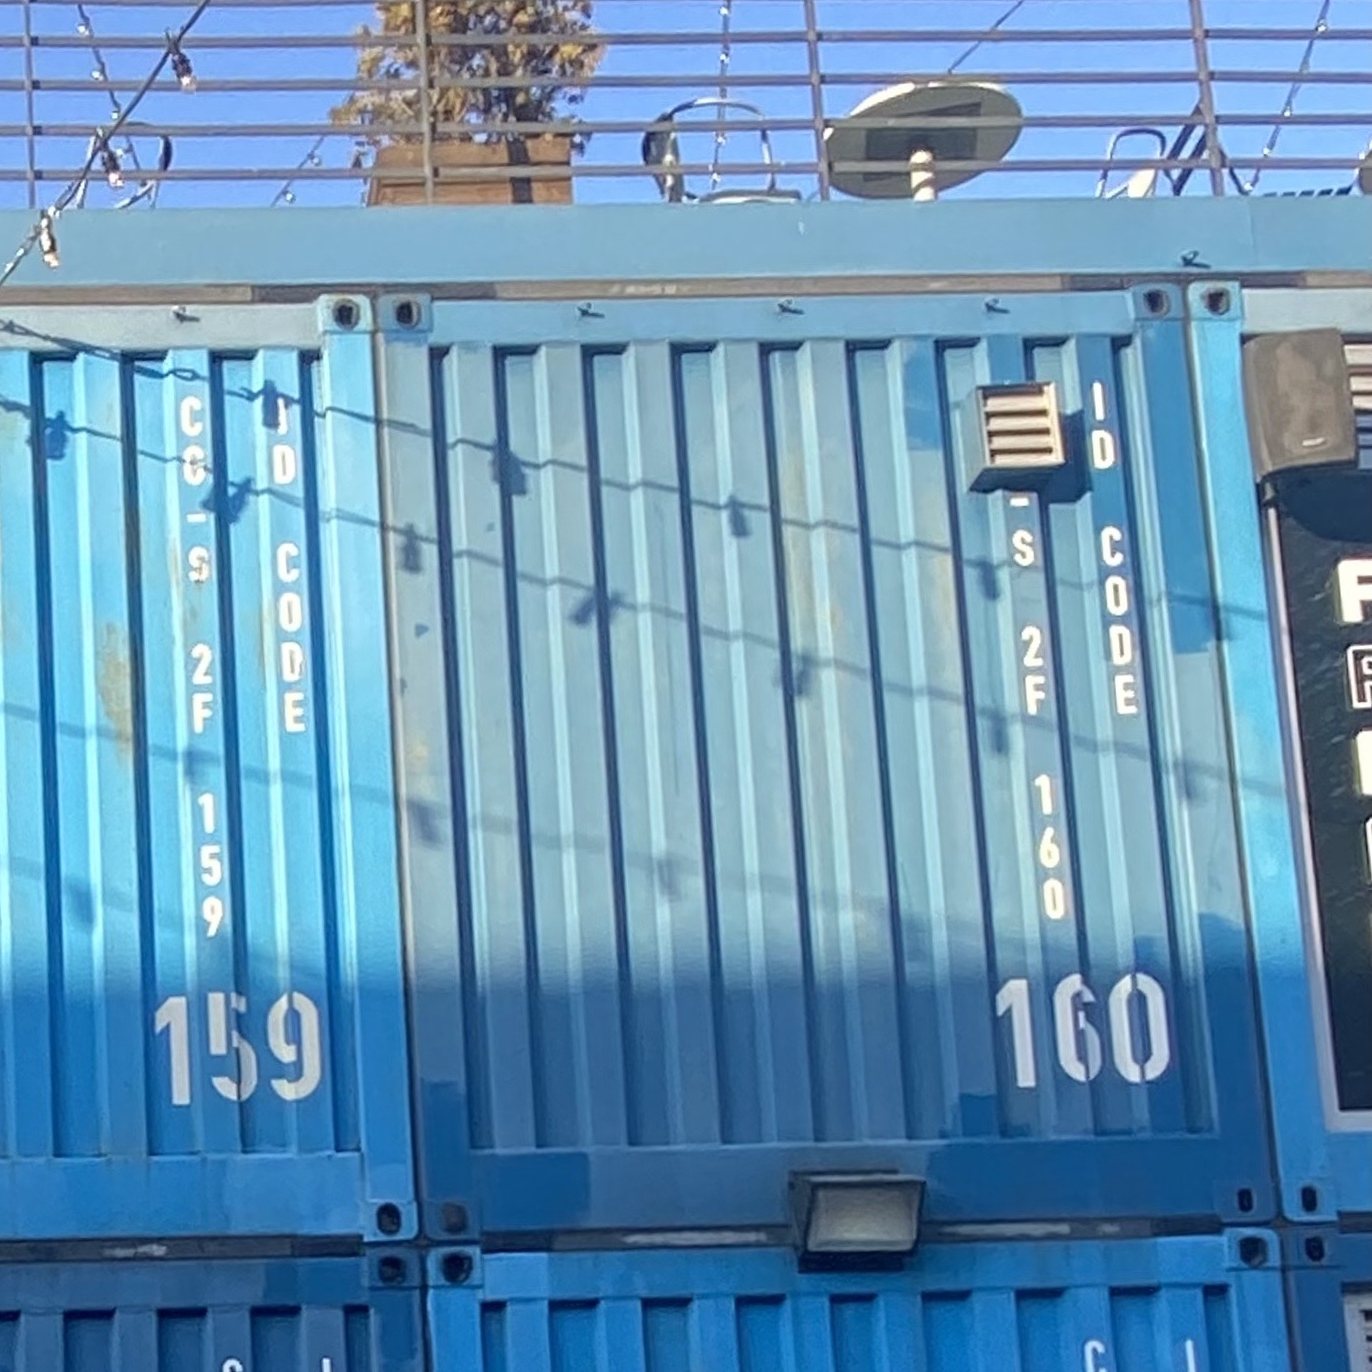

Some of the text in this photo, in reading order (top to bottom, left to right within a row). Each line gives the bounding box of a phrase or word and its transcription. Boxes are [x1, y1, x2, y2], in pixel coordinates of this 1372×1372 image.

[273, 398, 306, 733] ID CODE
[1092, 381, 1137, 715] ID CODE
[192, 645, 213, 734] 2F
[1019, 626, 1046, 715] 2F
[1034, 775, 1064, 919] 160
[198, 794, 223, 937] 159
[154, 992, 322, 1105] 159
[996, 973, 1170, 1087] 160
